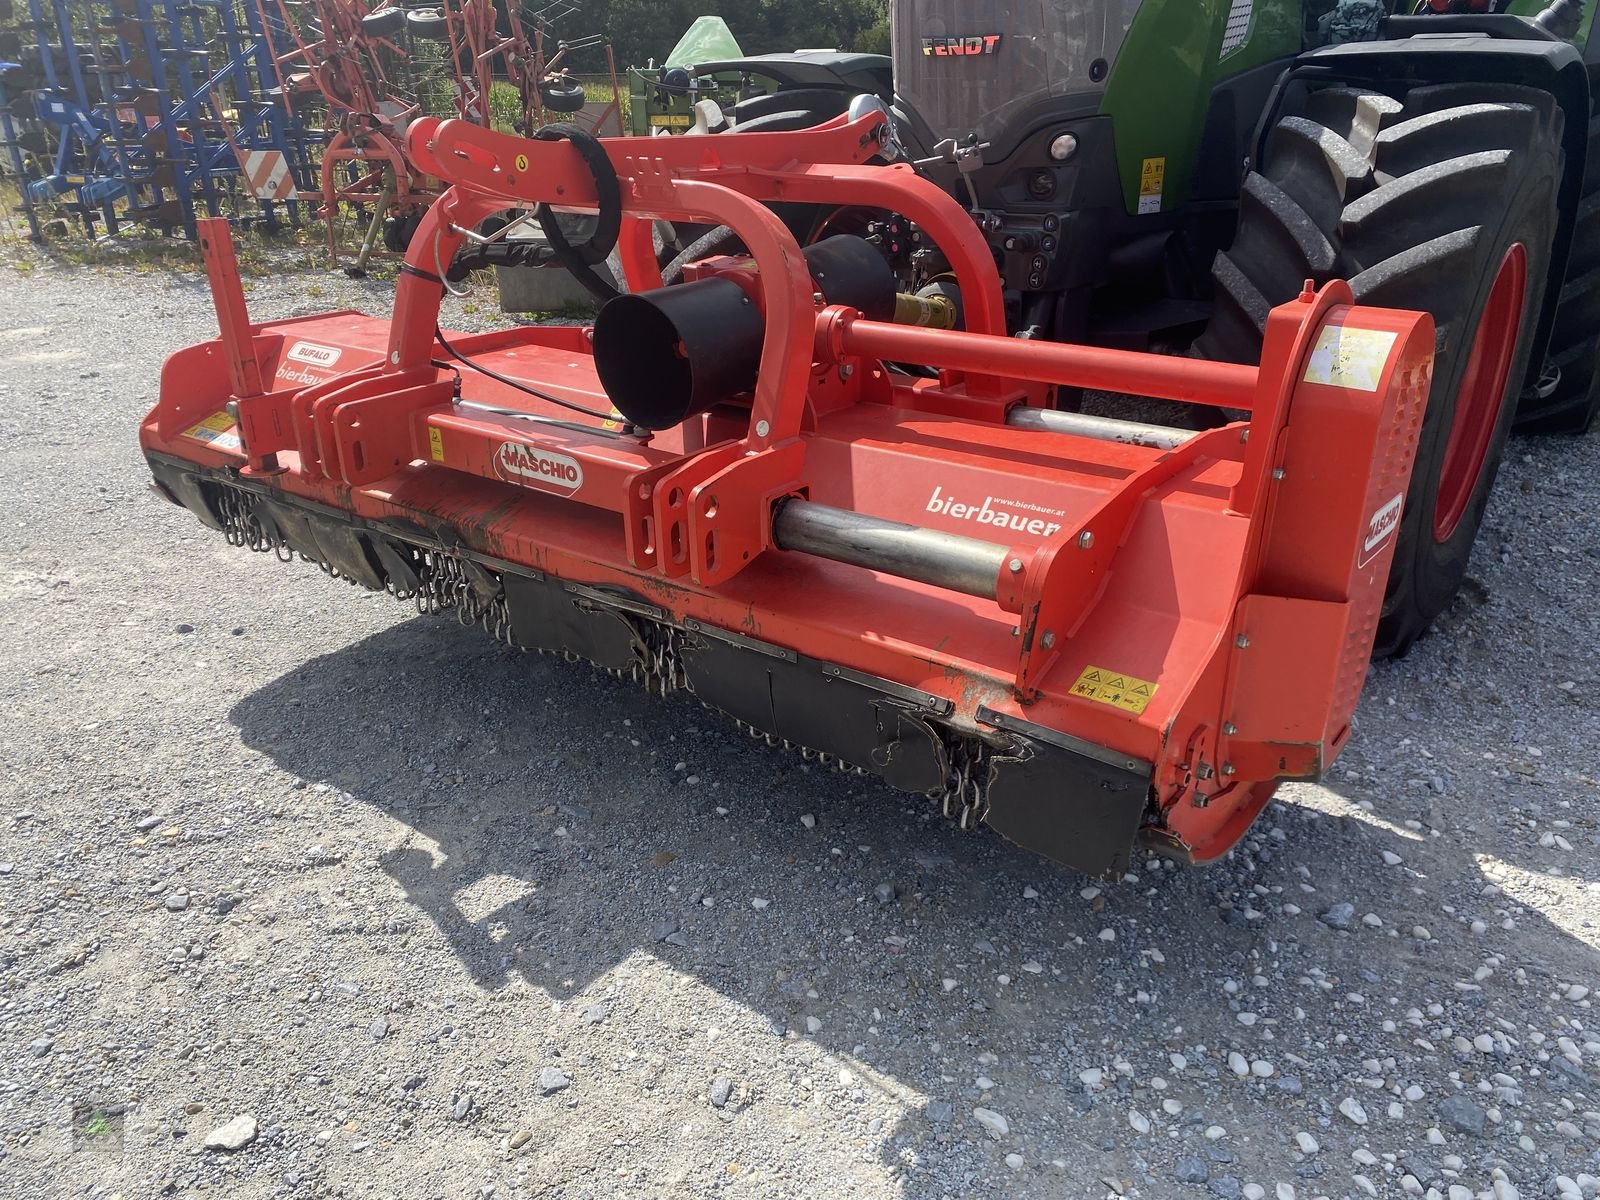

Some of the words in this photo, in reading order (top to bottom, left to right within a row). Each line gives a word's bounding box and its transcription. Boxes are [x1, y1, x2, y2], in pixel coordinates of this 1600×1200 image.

[921, 35, 1000, 56] FENDT
[298, 347, 330, 361] BUFALO
[275, 361, 325, 385] bierbau
[504, 448, 578, 482] MASCHIO
[925, 486, 1062, 537] bierbauer
[993, 497, 1066, 517] www.bierbauer.at
